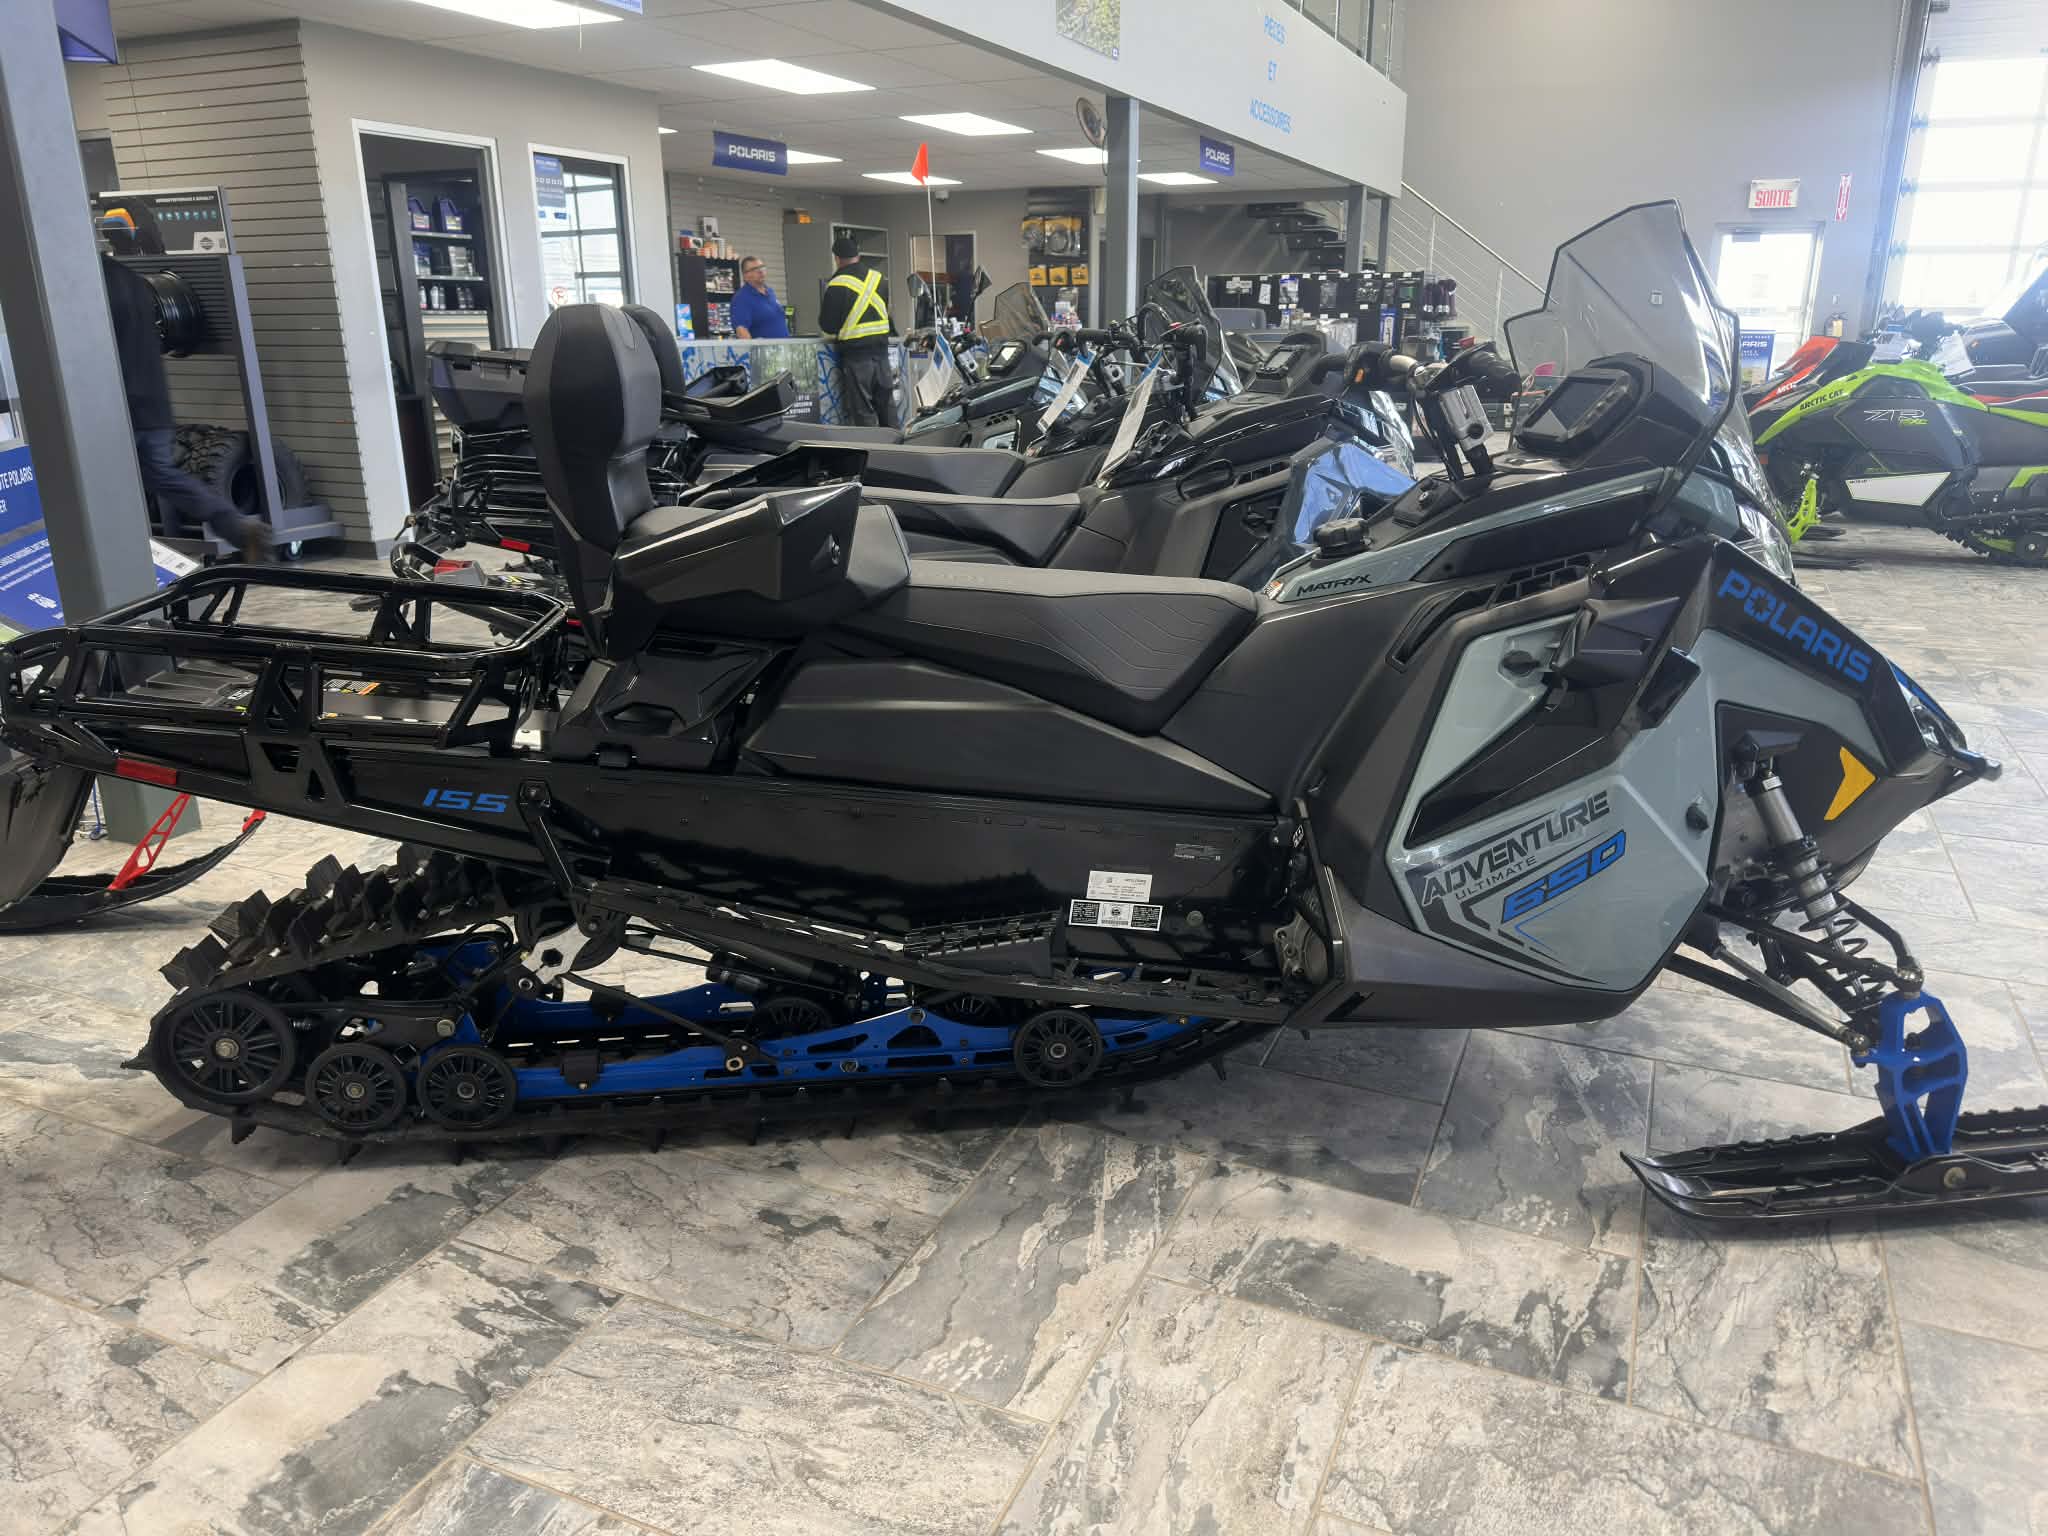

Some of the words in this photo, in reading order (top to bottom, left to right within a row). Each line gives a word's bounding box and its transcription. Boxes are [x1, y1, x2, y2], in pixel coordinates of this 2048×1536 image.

[1268, 60, 1277, 81] ET
[728, 144, 776, 162] POLARIS
[1205, 147, 1230, 165] POLARIS
[1755, 189, 1793, 206] SORTIE
[1799, 395, 1827, 410] ARCTIC
[1828, 389, 1844, 399] CAT
[8, 466, 33, 487] POLARIS
[1296, 574, 1372, 597] MATRYX
[1717, 568, 1873, 683] POLARIS
[422, 788, 511, 813] 155
[1421, 790, 1611, 907] ADVENTURE
[1454, 855, 1537, 901] ULTIMATE
[1501, 829, 1627, 924] 650
